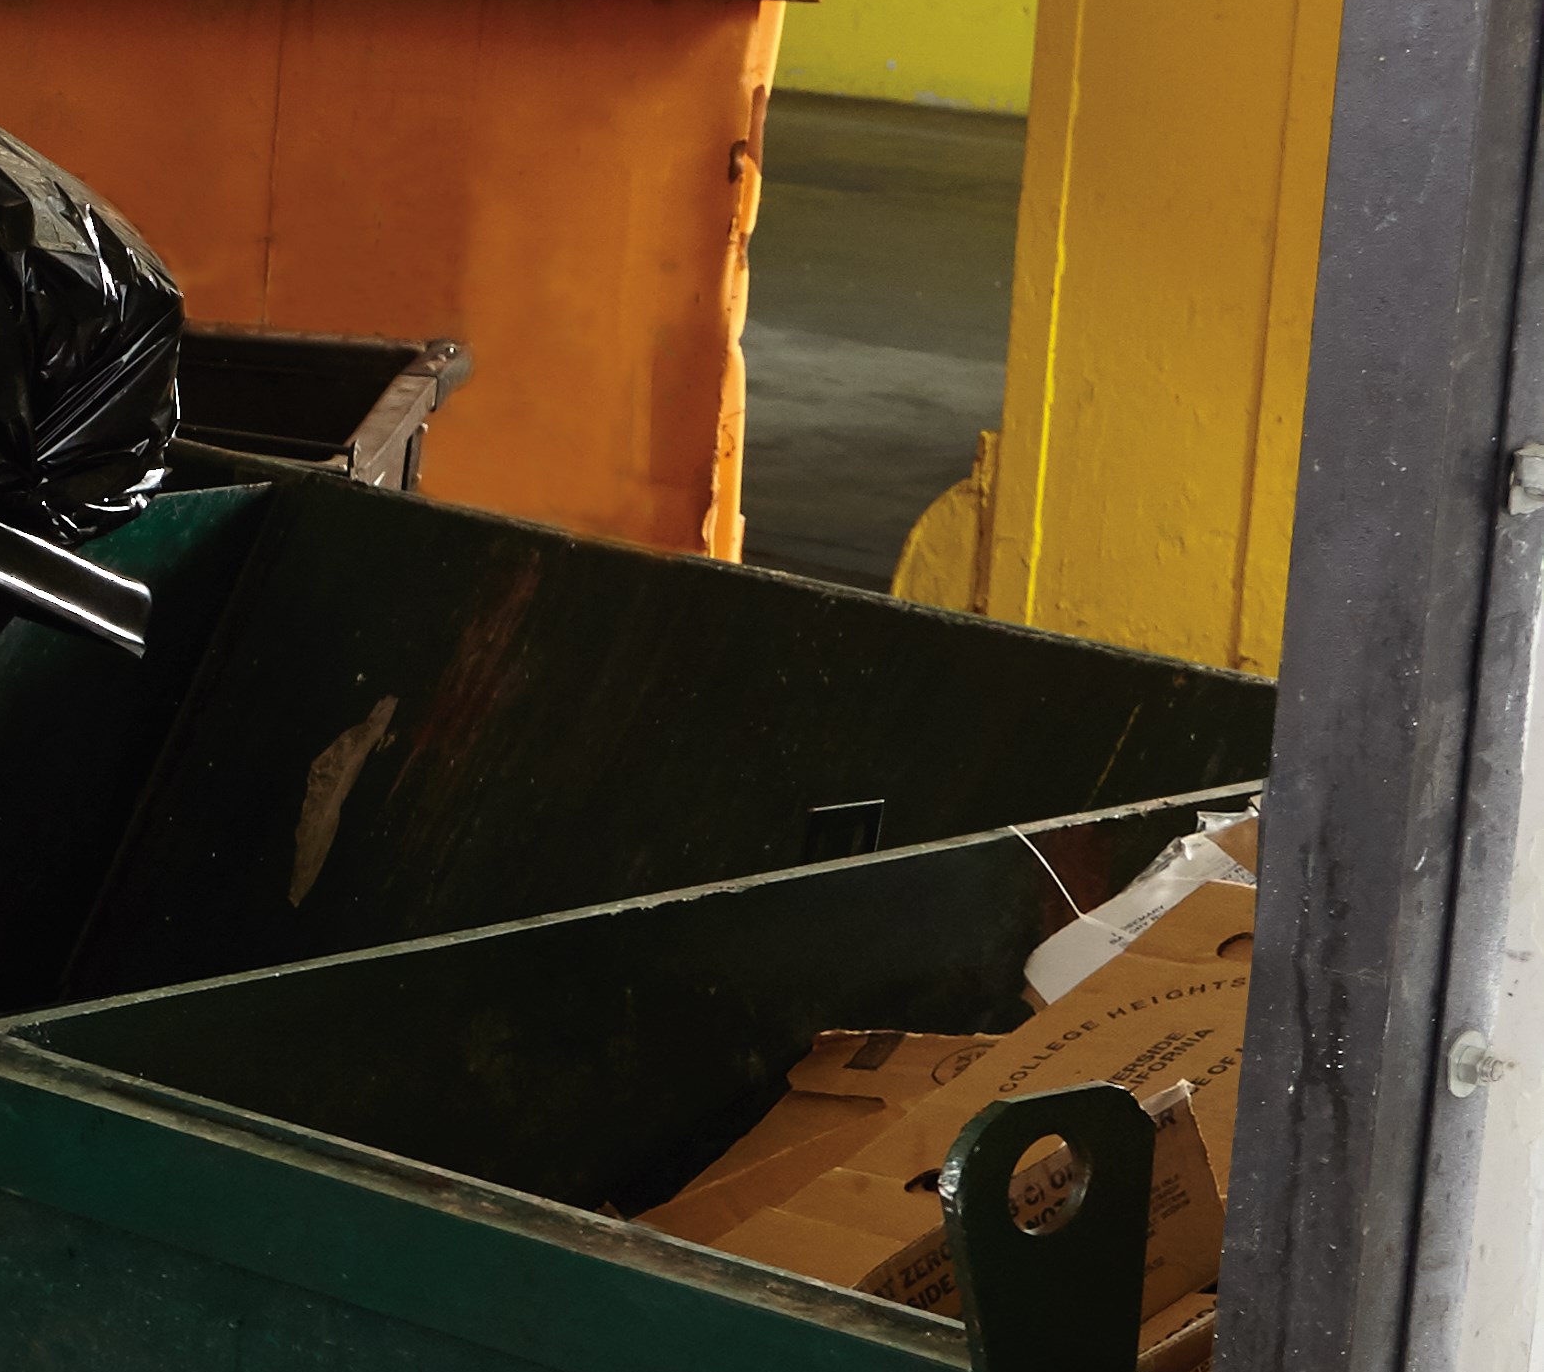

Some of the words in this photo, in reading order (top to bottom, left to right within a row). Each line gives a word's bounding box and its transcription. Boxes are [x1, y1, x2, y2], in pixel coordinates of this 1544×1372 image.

[999, 1019, 1100, 1094] COLLEGE
[1106, 977, 1247, 1020] HEIGHTS
[1207, 1055, 1236, 1076] OF
